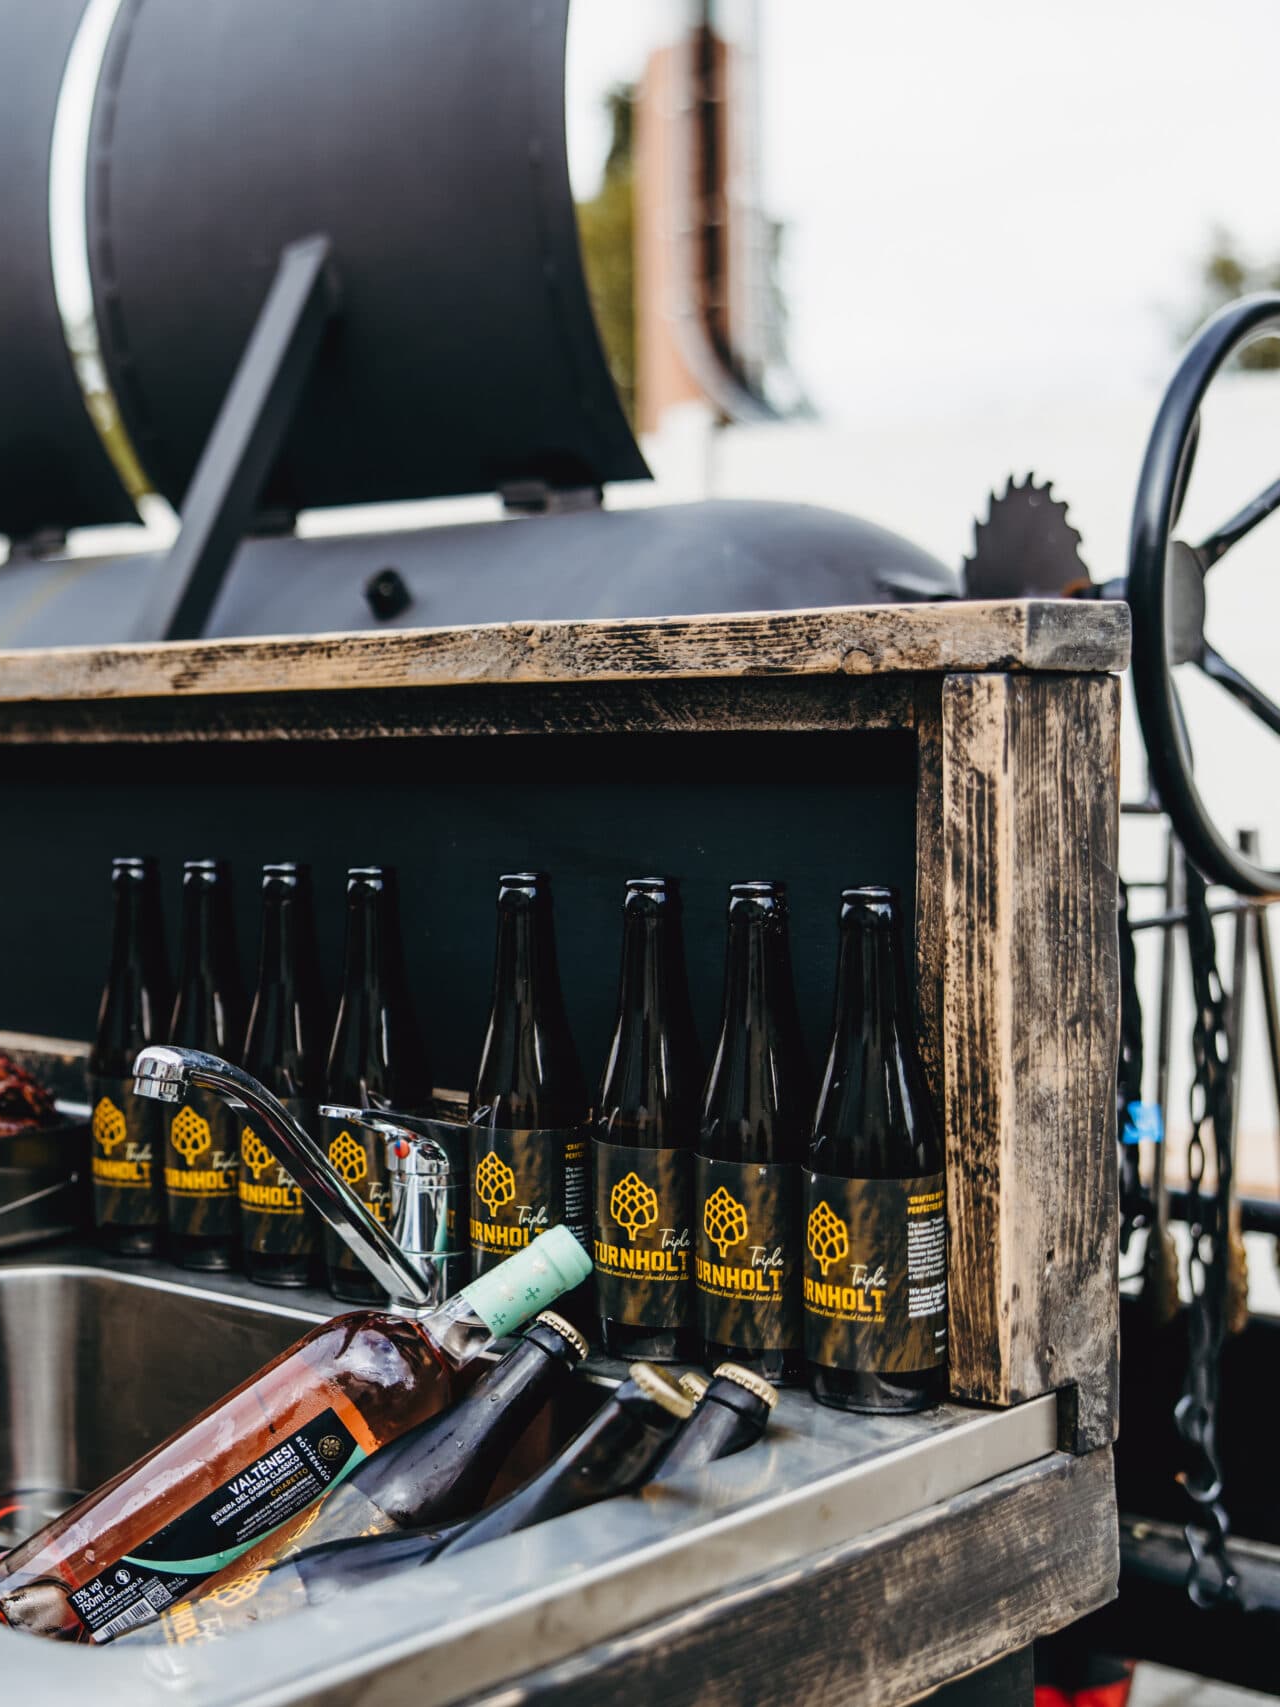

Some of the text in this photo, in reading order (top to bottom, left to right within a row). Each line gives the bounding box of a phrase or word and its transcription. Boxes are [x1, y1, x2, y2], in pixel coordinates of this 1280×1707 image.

[516, 1206, 548, 1231] Triple
[594, 1240, 688, 1272] TURNHOLT
[658, 1228, 690, 1256] Triple
[749, 1246, 784, 1274] Triple
[850, 1264, 887, 1294] Triple
[228, 1444, 296, 1496] VALTÈNESI
[296, 1436, 330, 1480] BOTTENAGO
[211, 1501, 236, 1522] RIVIERA
[236, 1493, 249, 1504] DEL
[248, 1477, 270, 1494] GARDA
[270, 1455, 300, 1479] CLASSICO
[270, 1468, 309, 1497] CHIARETTO
[72, 1578, 104, 1604] 13% vol
[78, 1592, 106, 1614] 750ml
[86, 1577, 144, 1620] www.bottenago.it
